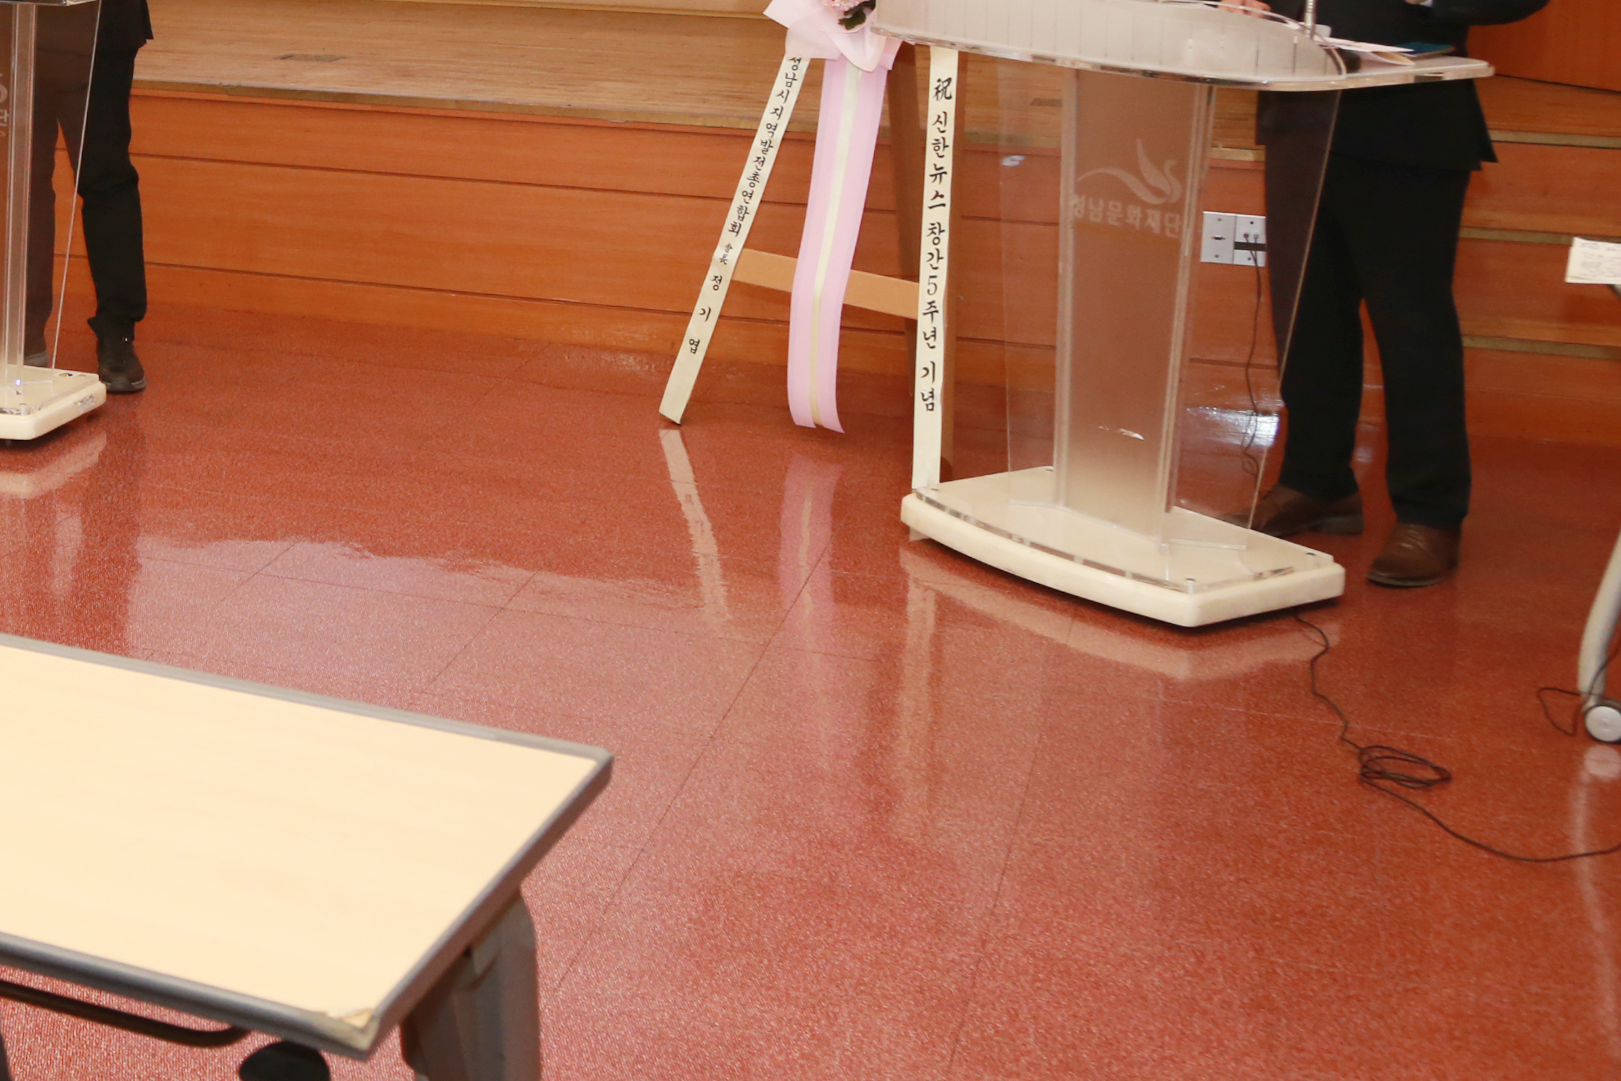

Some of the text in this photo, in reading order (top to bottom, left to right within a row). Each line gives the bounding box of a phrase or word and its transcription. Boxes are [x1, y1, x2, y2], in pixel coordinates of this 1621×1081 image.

[728, 57, 803, 237] 성남시지역발전총연합회
[920, 77, 953, 412] 祝 신한뉴스 창간5주년 기념
